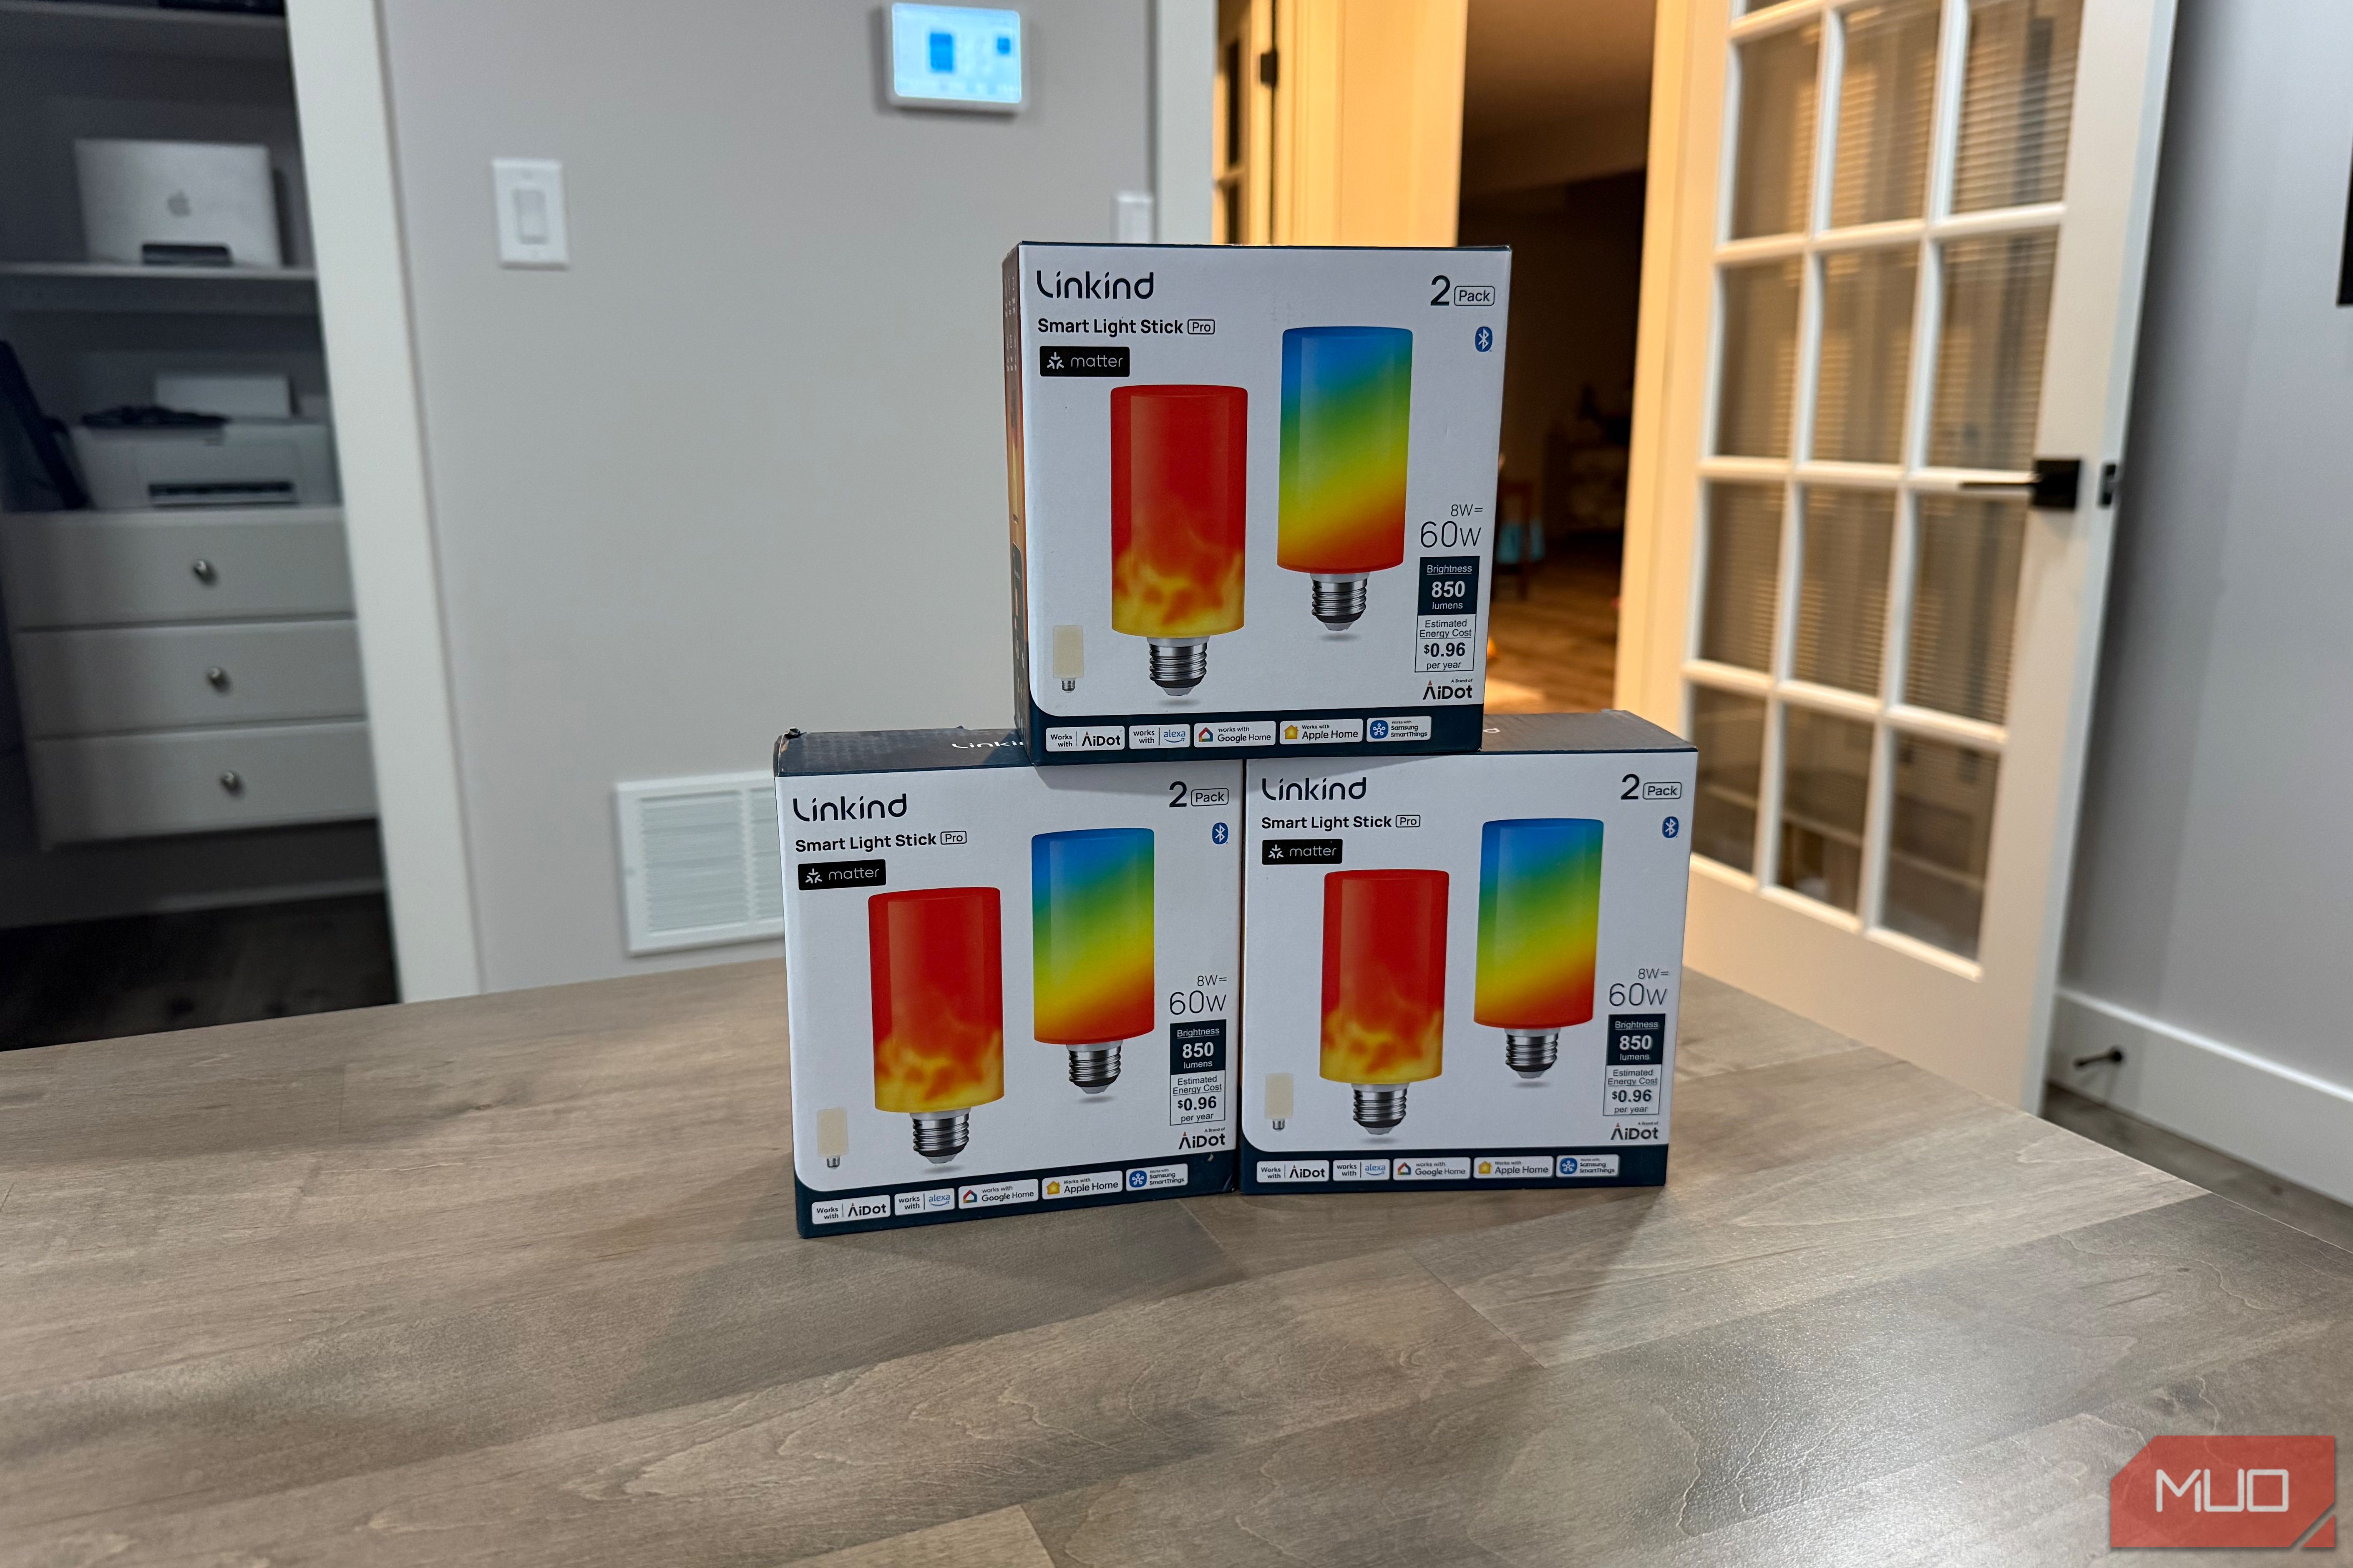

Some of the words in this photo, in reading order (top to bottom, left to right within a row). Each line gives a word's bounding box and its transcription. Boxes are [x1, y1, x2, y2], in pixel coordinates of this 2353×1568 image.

[1037, 270, 1154, 299] Linkind
[1430, 275, 1450, 306] 2
[1459, 290, 1490, 302] Pack
[1038, 318, 1089, 333] Smart
[1094, 319, 1136, 337] Light
[1140, 319, 1183, 334] Stick
[1192, 322, 1211, 332] Pro
[1071, 356, 1123, 369] matter
[1427, 565, 1472, 574] Brightness
[1432, 581, 1465, 598] 850
[1425, 619, 1467, 628] Estimated
[1419, 630, 1450, 638] Energy
[1424, 642, 1465, 657] $0.96
[1443, 662, 1462, 670] year
[1422, 680, 1472, 700] AiDot
[1082, 731, 1120, 746] AiDot
[1218, 734, 1247, 743] Google
[1302, 731, 1329, 741] Apple
[1169, 781, 1187, 807] 2
[1196, 792, 1224, 802] Pack
[1262, 777, 1367, 801] Linkind
[1621, 774, 1639, 800] 2
[1648, 785, 1677, 796] Pack
[793, 793, 907, 822] Linkind
[1262, 817, 1307, 829] Smart
[1311, 817, 1349, 832] Light
[1353, 816, 1392, 827] Stick
[795, 838, 846, 852] Smart
[850, 835, 891, 852] Light
[895, 833, 936, 847] Stick
[945, 834, 963, 842] Pro
[1290, 846, 1336, 857] matter
[828, 867, 879, 880] matter
[1177, 1028, 1220, 1037] Brightness
[1182, 1042, 1214, 1058] 850
[1619, 1035, 1652, 1050] 850
[1178, 1075, 1217, 1086] Estimated
[1612, 1089, 1651, 1102] $0.96
[1178, 1096, 1217, 1111] $0.96
[1197, 1113, 1214, 1122] year
[1611, 1123, 1658, 1140] AiDot
[1178, 1131, 1225, 1149] AiDot
[1289, 1165, 1325, 1178] AiDot
[1495, 1166, 1520, 1175] Apple
[1064, 1184, 1090, 1194] Apple
[1092, 1181, 1118, 1190] Home
[981, 1193, 1010, 1201] Google
[848, 1202, 886, 1217] AiDot
